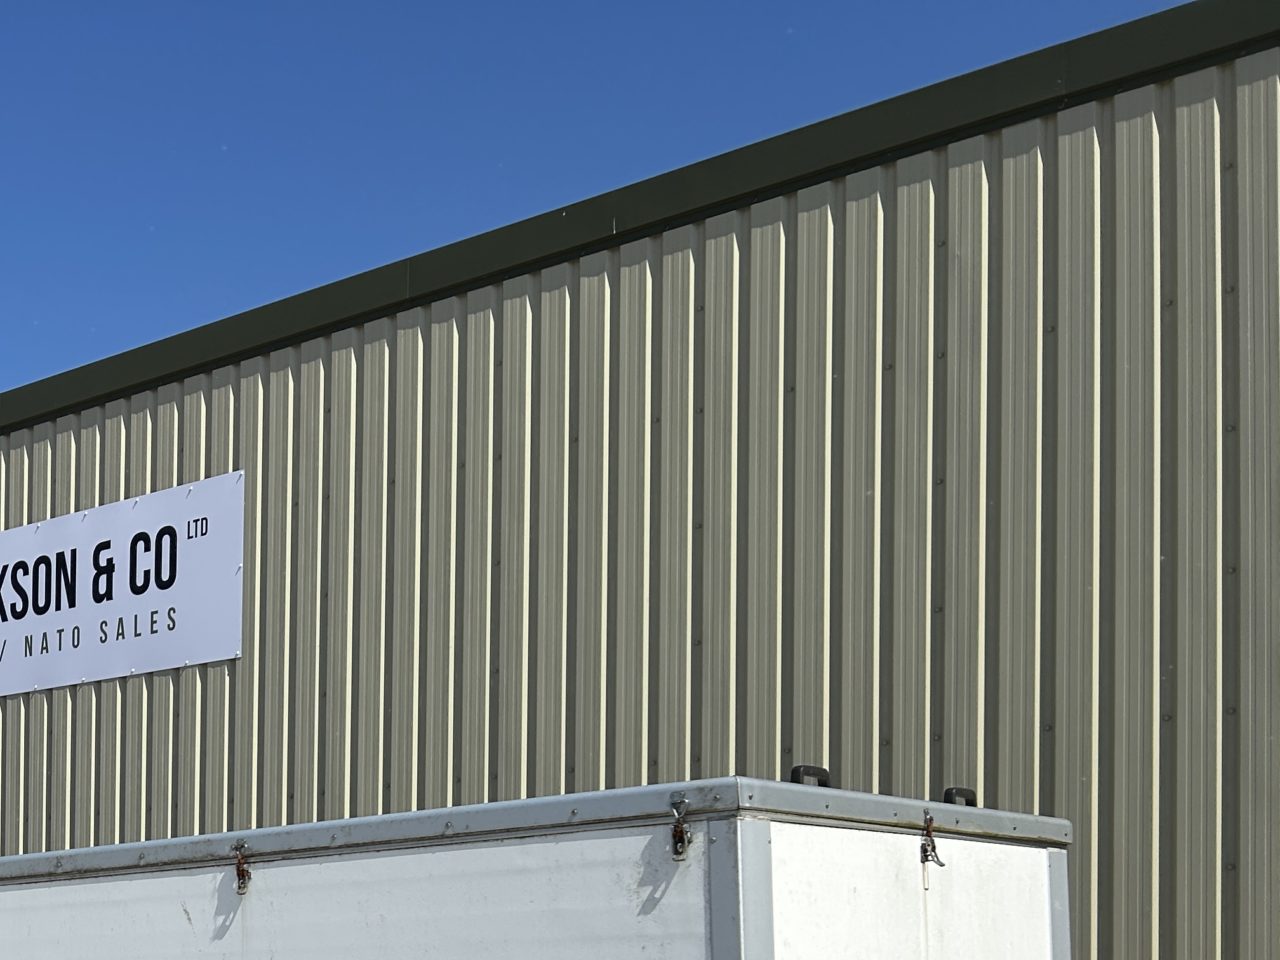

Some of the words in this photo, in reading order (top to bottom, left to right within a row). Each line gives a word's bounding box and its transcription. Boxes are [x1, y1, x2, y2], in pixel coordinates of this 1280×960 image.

[92, 539, 115, 604] &
[129, 525, 178, 596] CO
[187, 517, 209, 540] LTD
[24, 625, 81, 658] NATO
[99, 607, 177, 644] SALES
